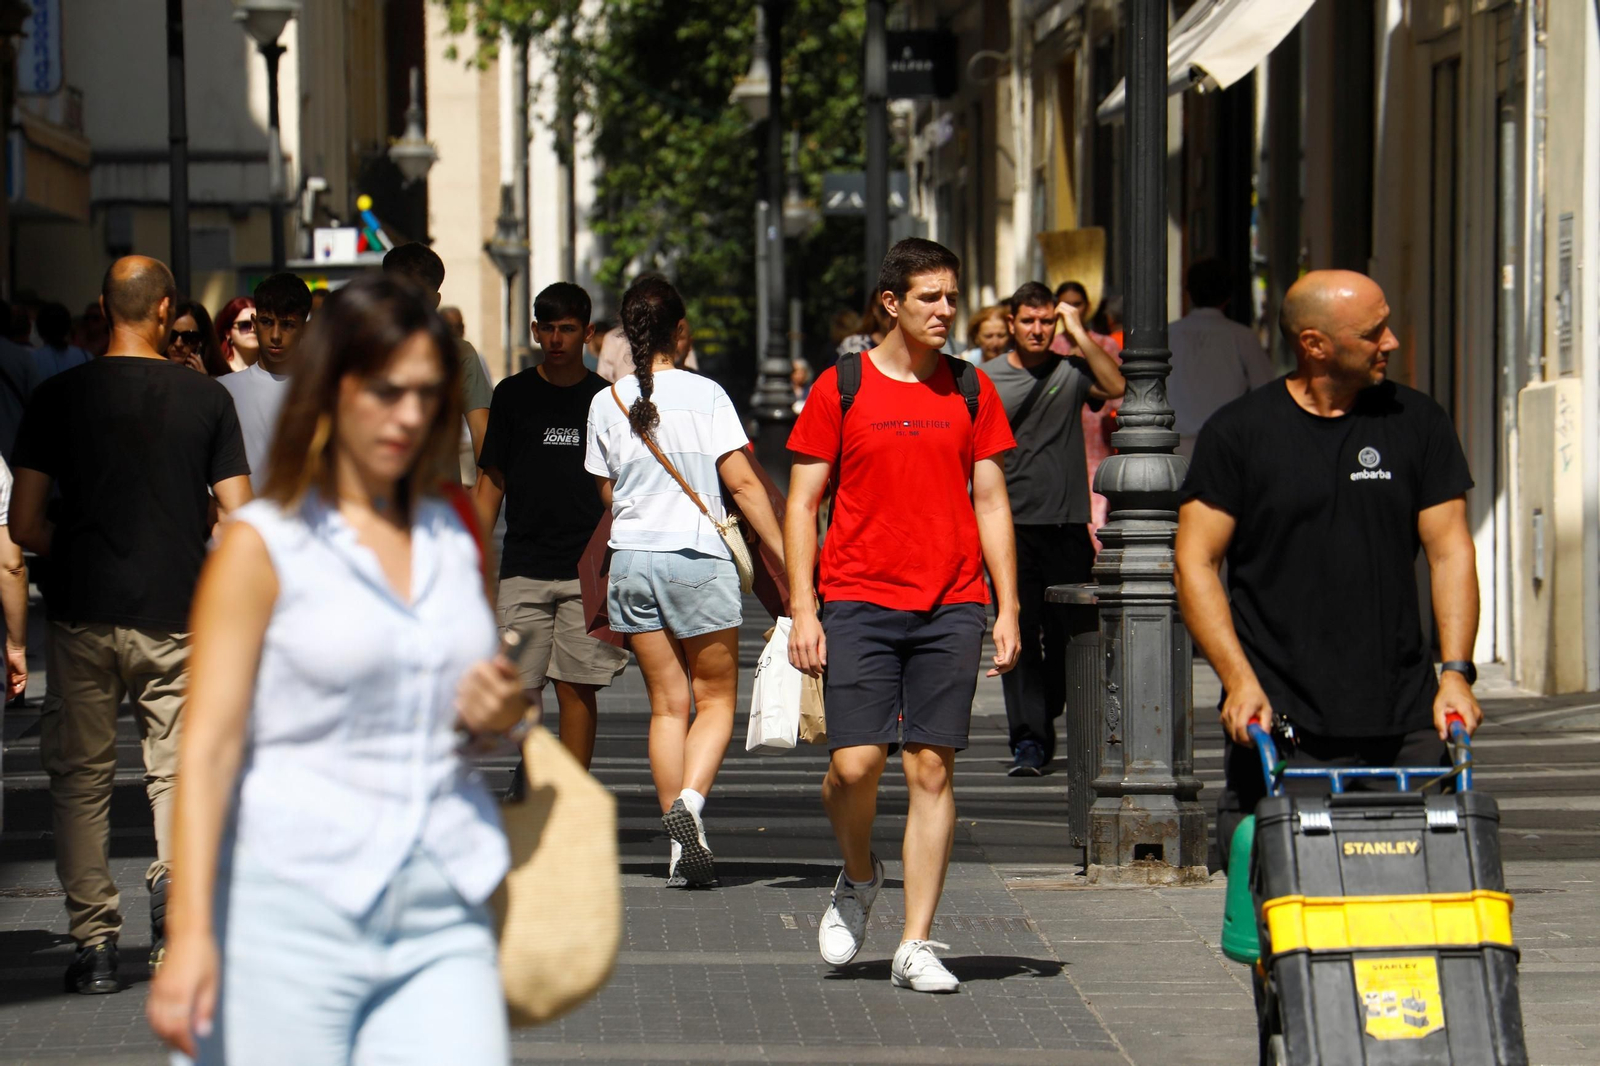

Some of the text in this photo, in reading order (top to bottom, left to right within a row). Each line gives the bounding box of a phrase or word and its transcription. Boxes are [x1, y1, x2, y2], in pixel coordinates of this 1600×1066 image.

[827, 190, 904, 208] ZAA
[870, 419, 951, 431] TOMMY HILFIGER
[543, 434, 580, 443] JONES
[1350, 468, 1392, 481] embarba
[1343, 840, 1418, 855] STANLEY
[1372, 962, 1418, 971] STANLEY
